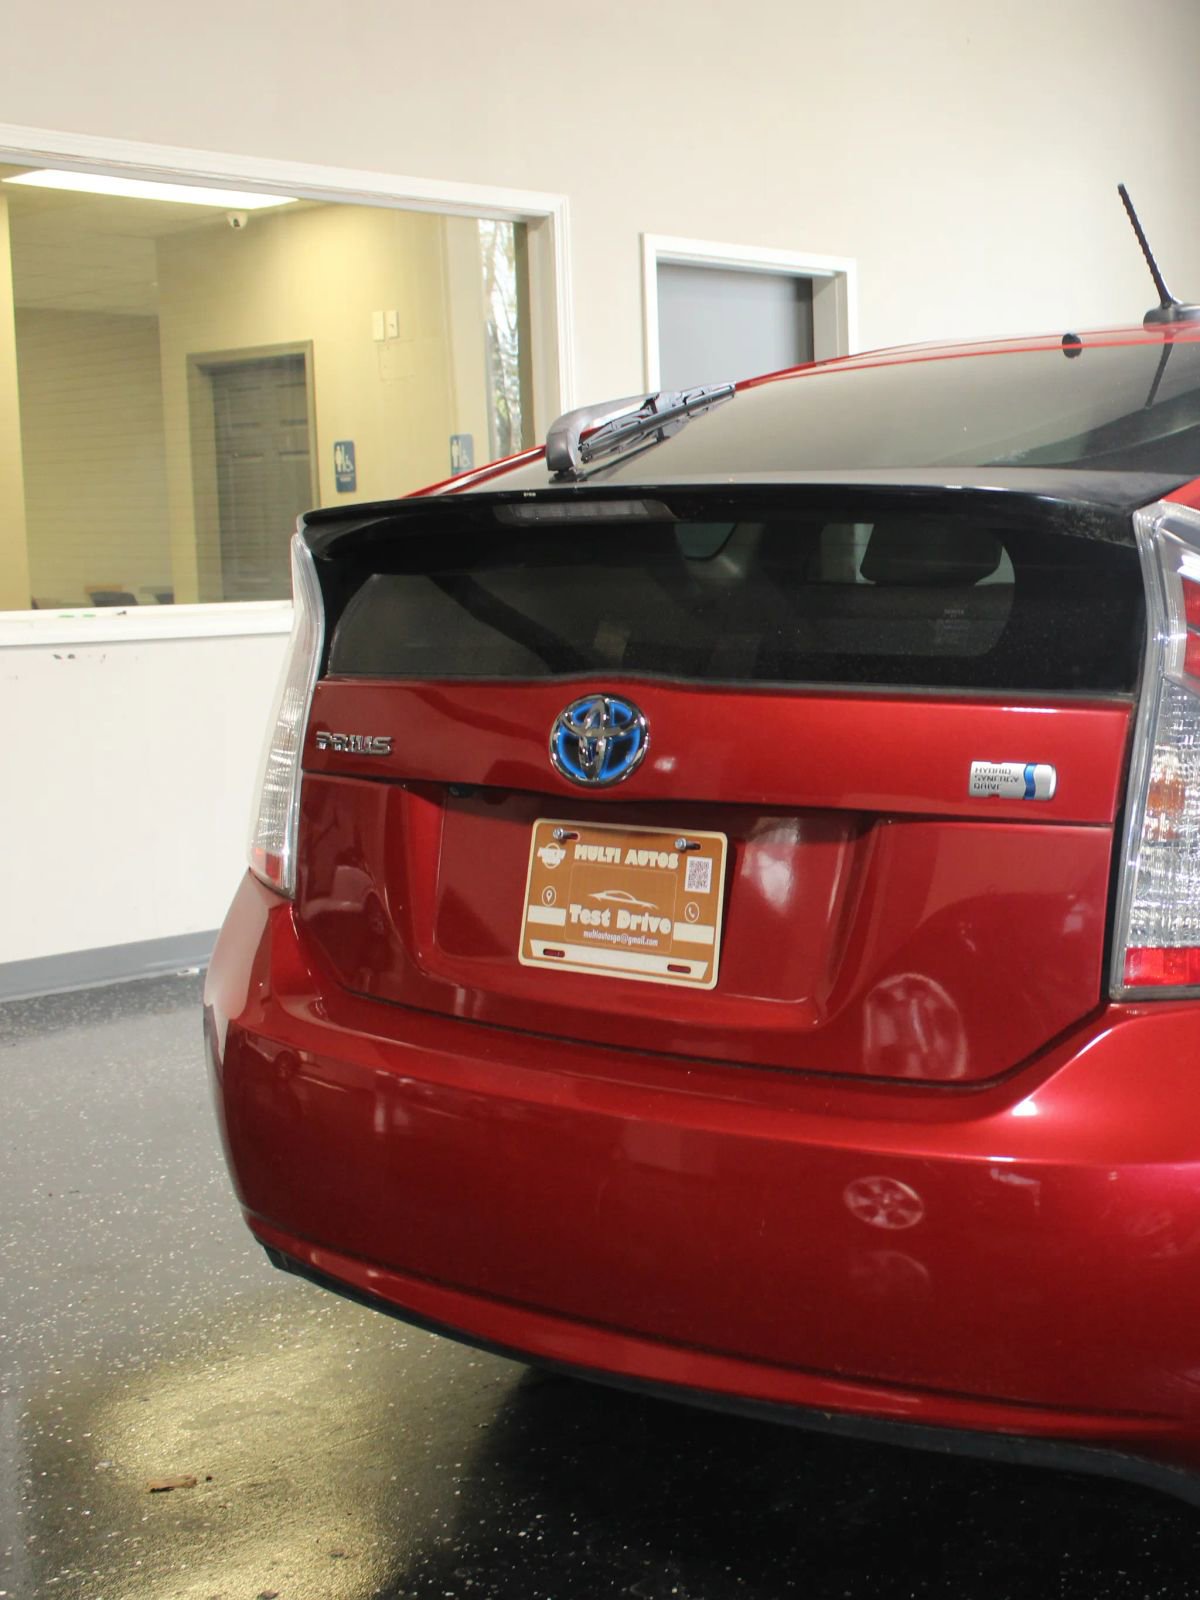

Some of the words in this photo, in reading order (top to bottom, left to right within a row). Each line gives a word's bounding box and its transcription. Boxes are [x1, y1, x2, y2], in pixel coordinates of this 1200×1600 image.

[315, 731, 392, 755] PRIUS
[974, 767, 1012, 775] HYBRID
[974, 774, 1020, 783] SYNERGY
[973, 782, 1001, 790] DRIVE
[574, 844, 621, 864] MULTI
[624, 849, 679, 869] AUTOS
[569, 904, 611, 927] Test
[616, 909, 672, 935] Drive
